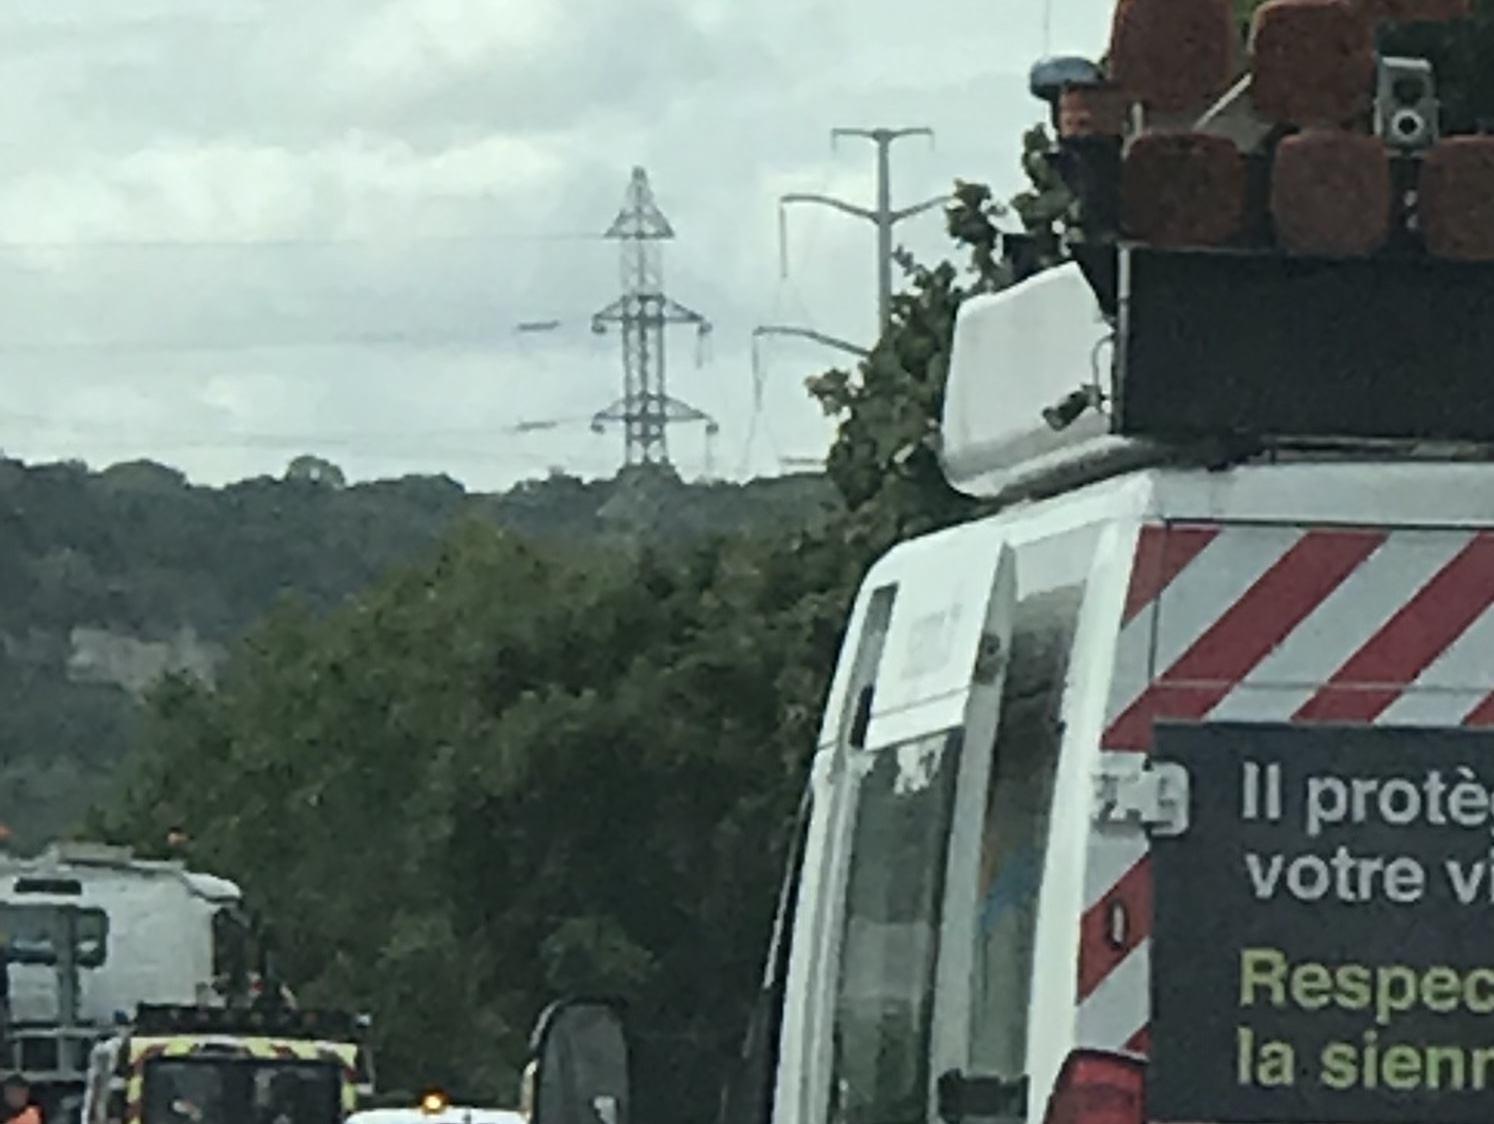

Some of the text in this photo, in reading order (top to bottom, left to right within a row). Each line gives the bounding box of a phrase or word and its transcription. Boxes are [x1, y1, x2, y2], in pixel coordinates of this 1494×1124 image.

[1241, 761, 1282, 820] Il
[1245, 845, 1426, 902] votre
[1237, 1026, 1295, 1086] la
